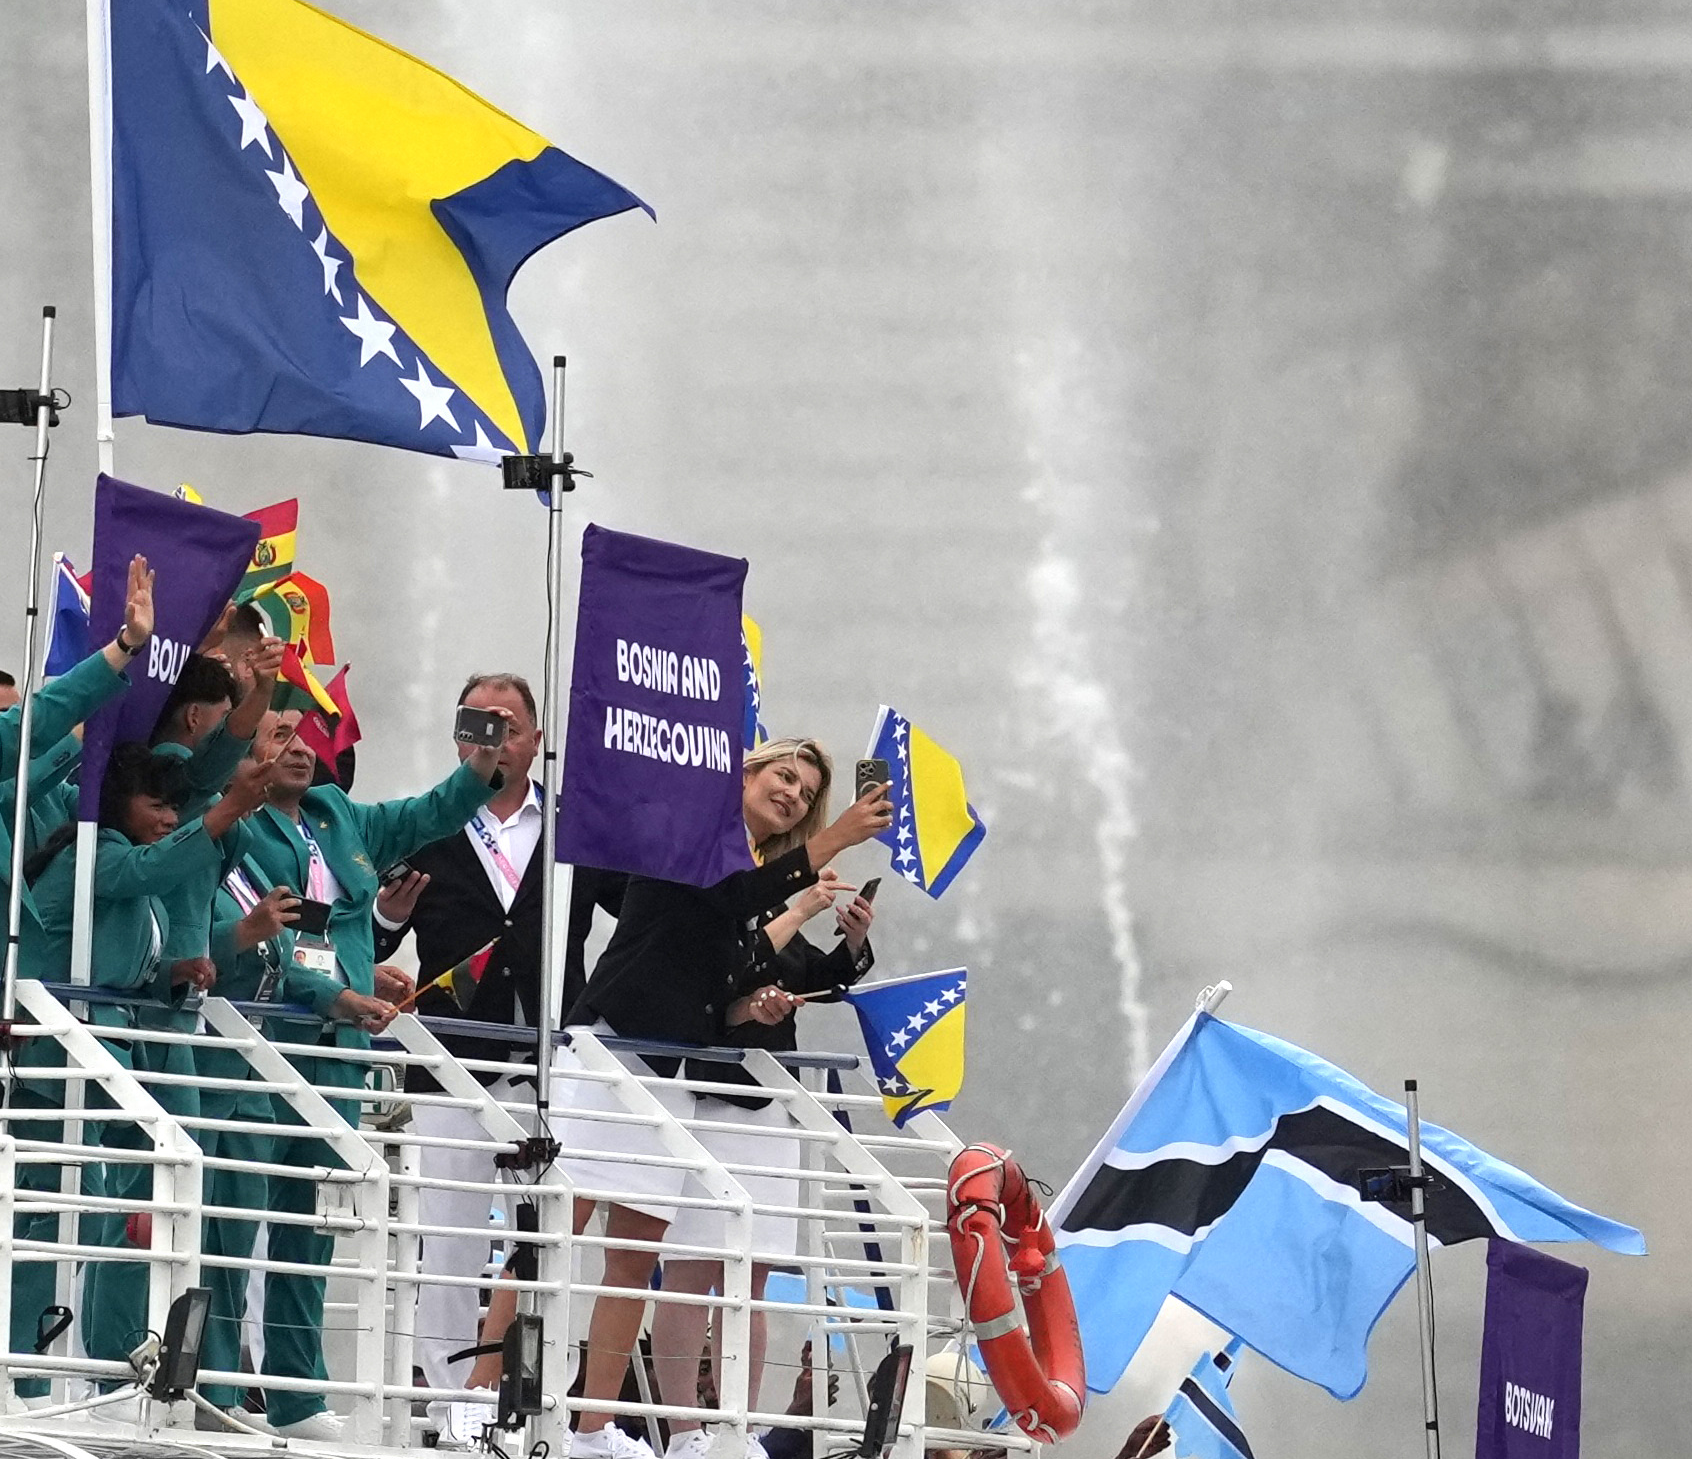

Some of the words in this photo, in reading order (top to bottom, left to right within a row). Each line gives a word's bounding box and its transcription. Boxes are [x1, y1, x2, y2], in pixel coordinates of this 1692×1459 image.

[616, 638, 678, 695] BOSNIA
[681, 654, 721, 701] AND
[603, 706, 732, 774] HERZEGOVINA
